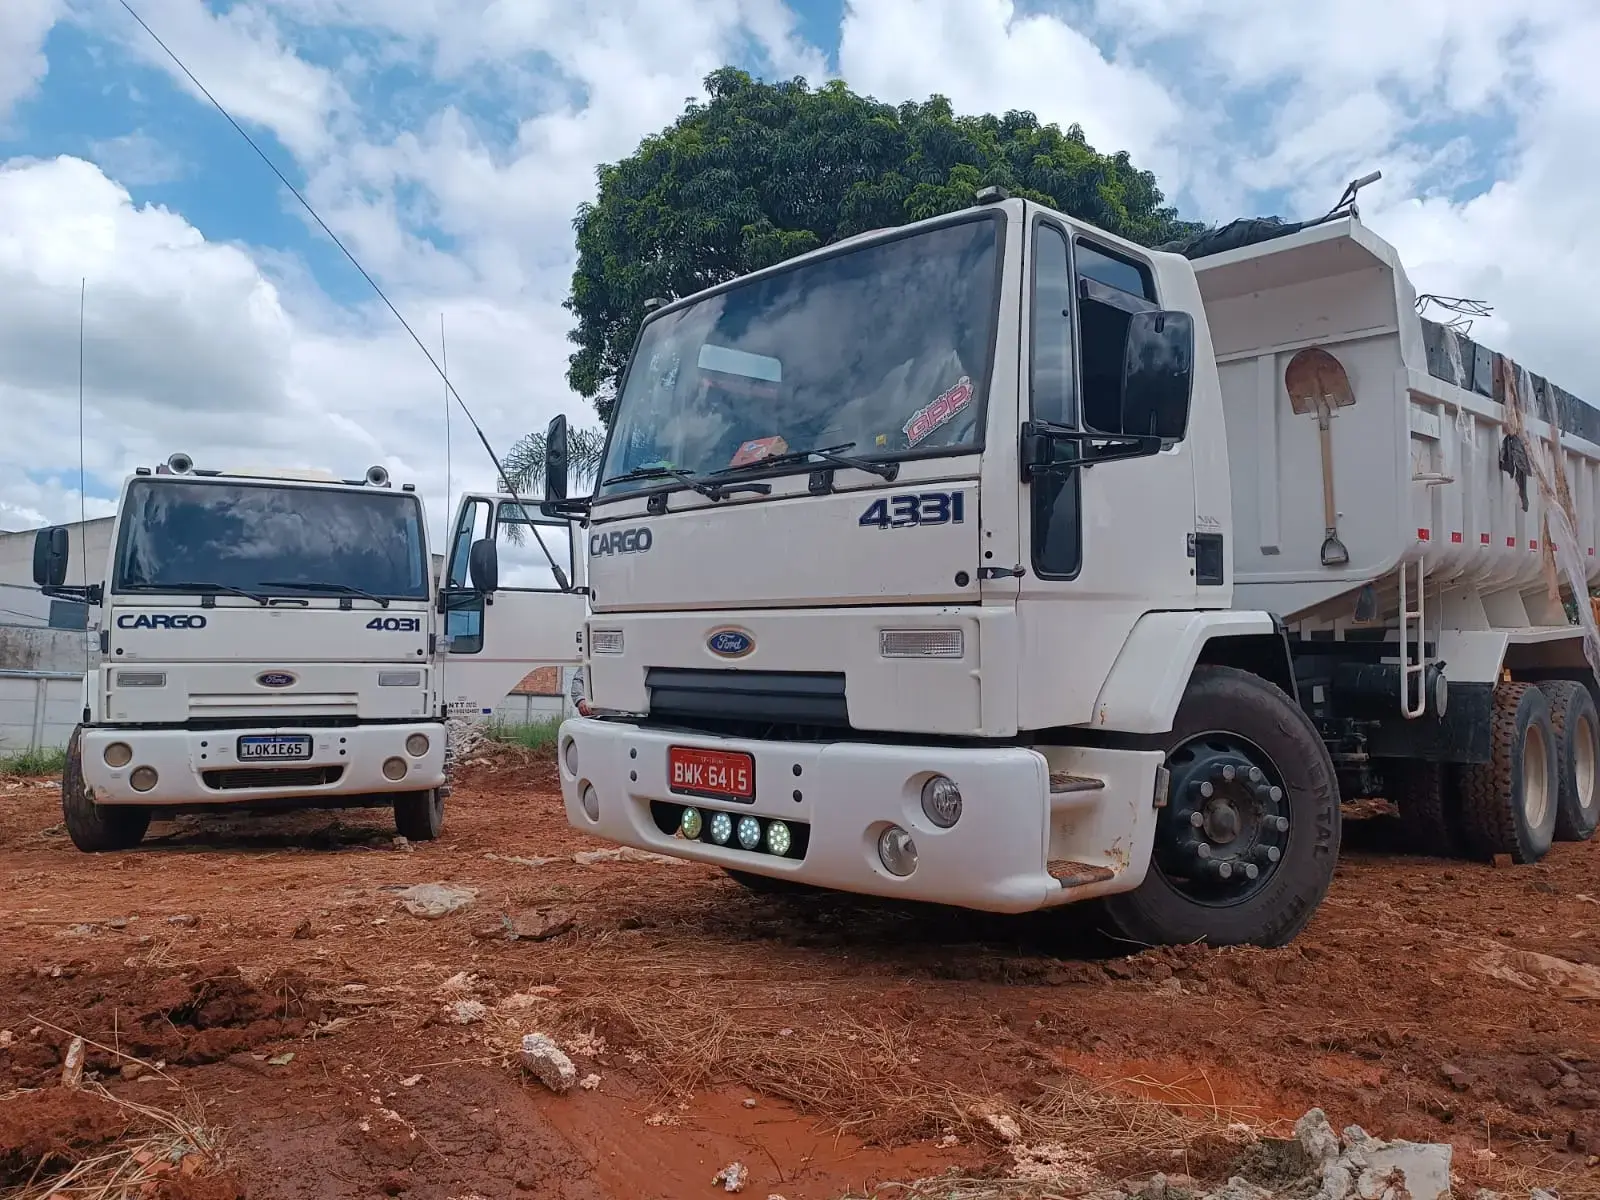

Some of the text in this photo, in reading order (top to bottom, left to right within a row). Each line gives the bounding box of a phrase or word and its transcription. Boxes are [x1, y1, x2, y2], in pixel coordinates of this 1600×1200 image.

[858, 491, 964, 529] 4331
[590, 526, 653, 558] CARGO
[117, 614, 207, 630] CARGO
[366, 617, 420, 632] 4031
[717, 634, 743, 650] Ford
[246, 743, 303, 756] LOK1E65
